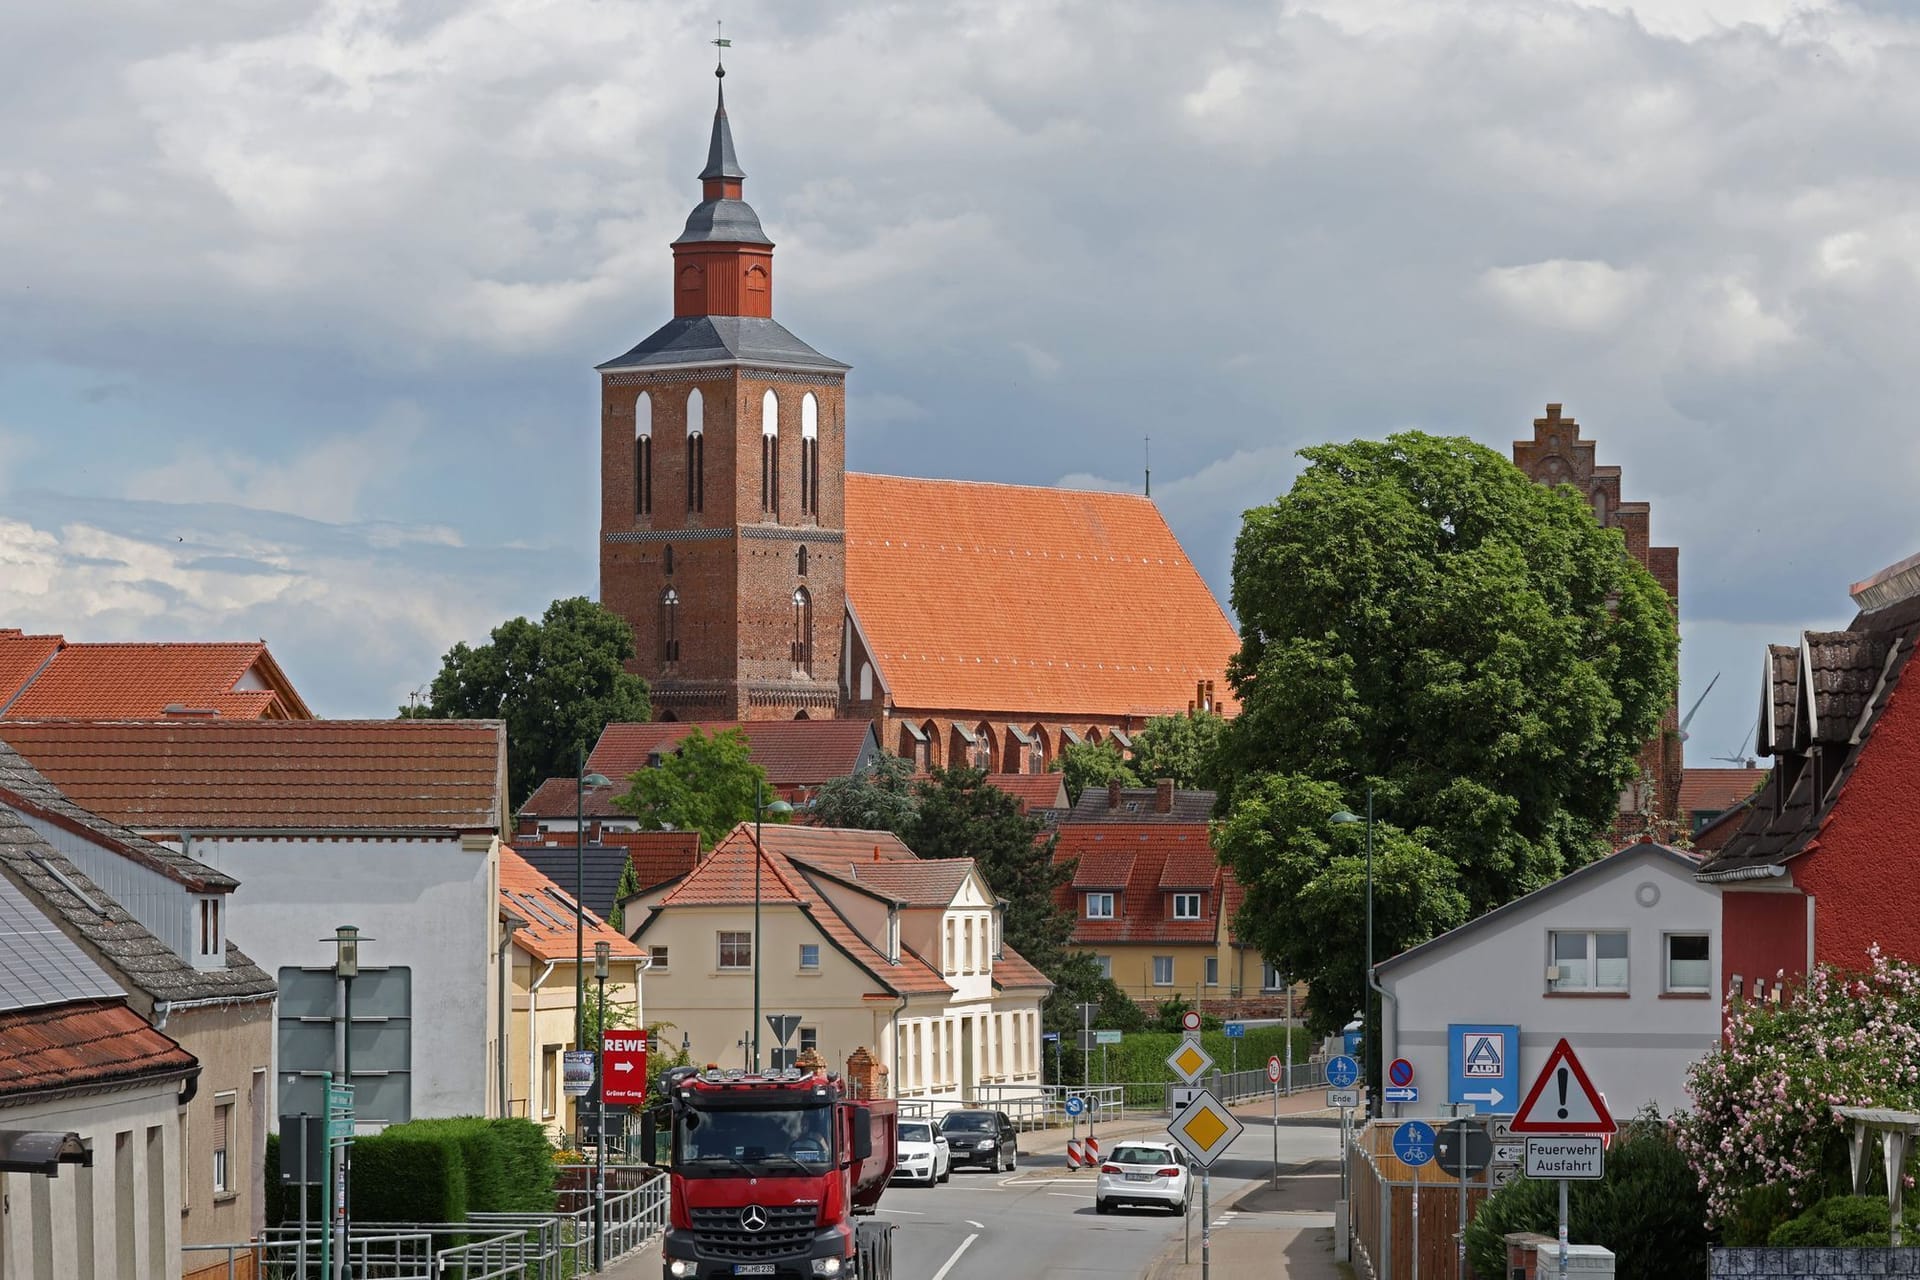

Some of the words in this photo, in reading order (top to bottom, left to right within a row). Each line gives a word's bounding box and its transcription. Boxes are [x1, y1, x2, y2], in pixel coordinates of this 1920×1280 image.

[604, 1040, 646, 1051] REWE
[1471, 1065, 1497, 1073] ALDI
[1530, 1144, 1598, 1155] Feuerwehr
[1537, 1160, 1592, 1171] Ausfahrt
